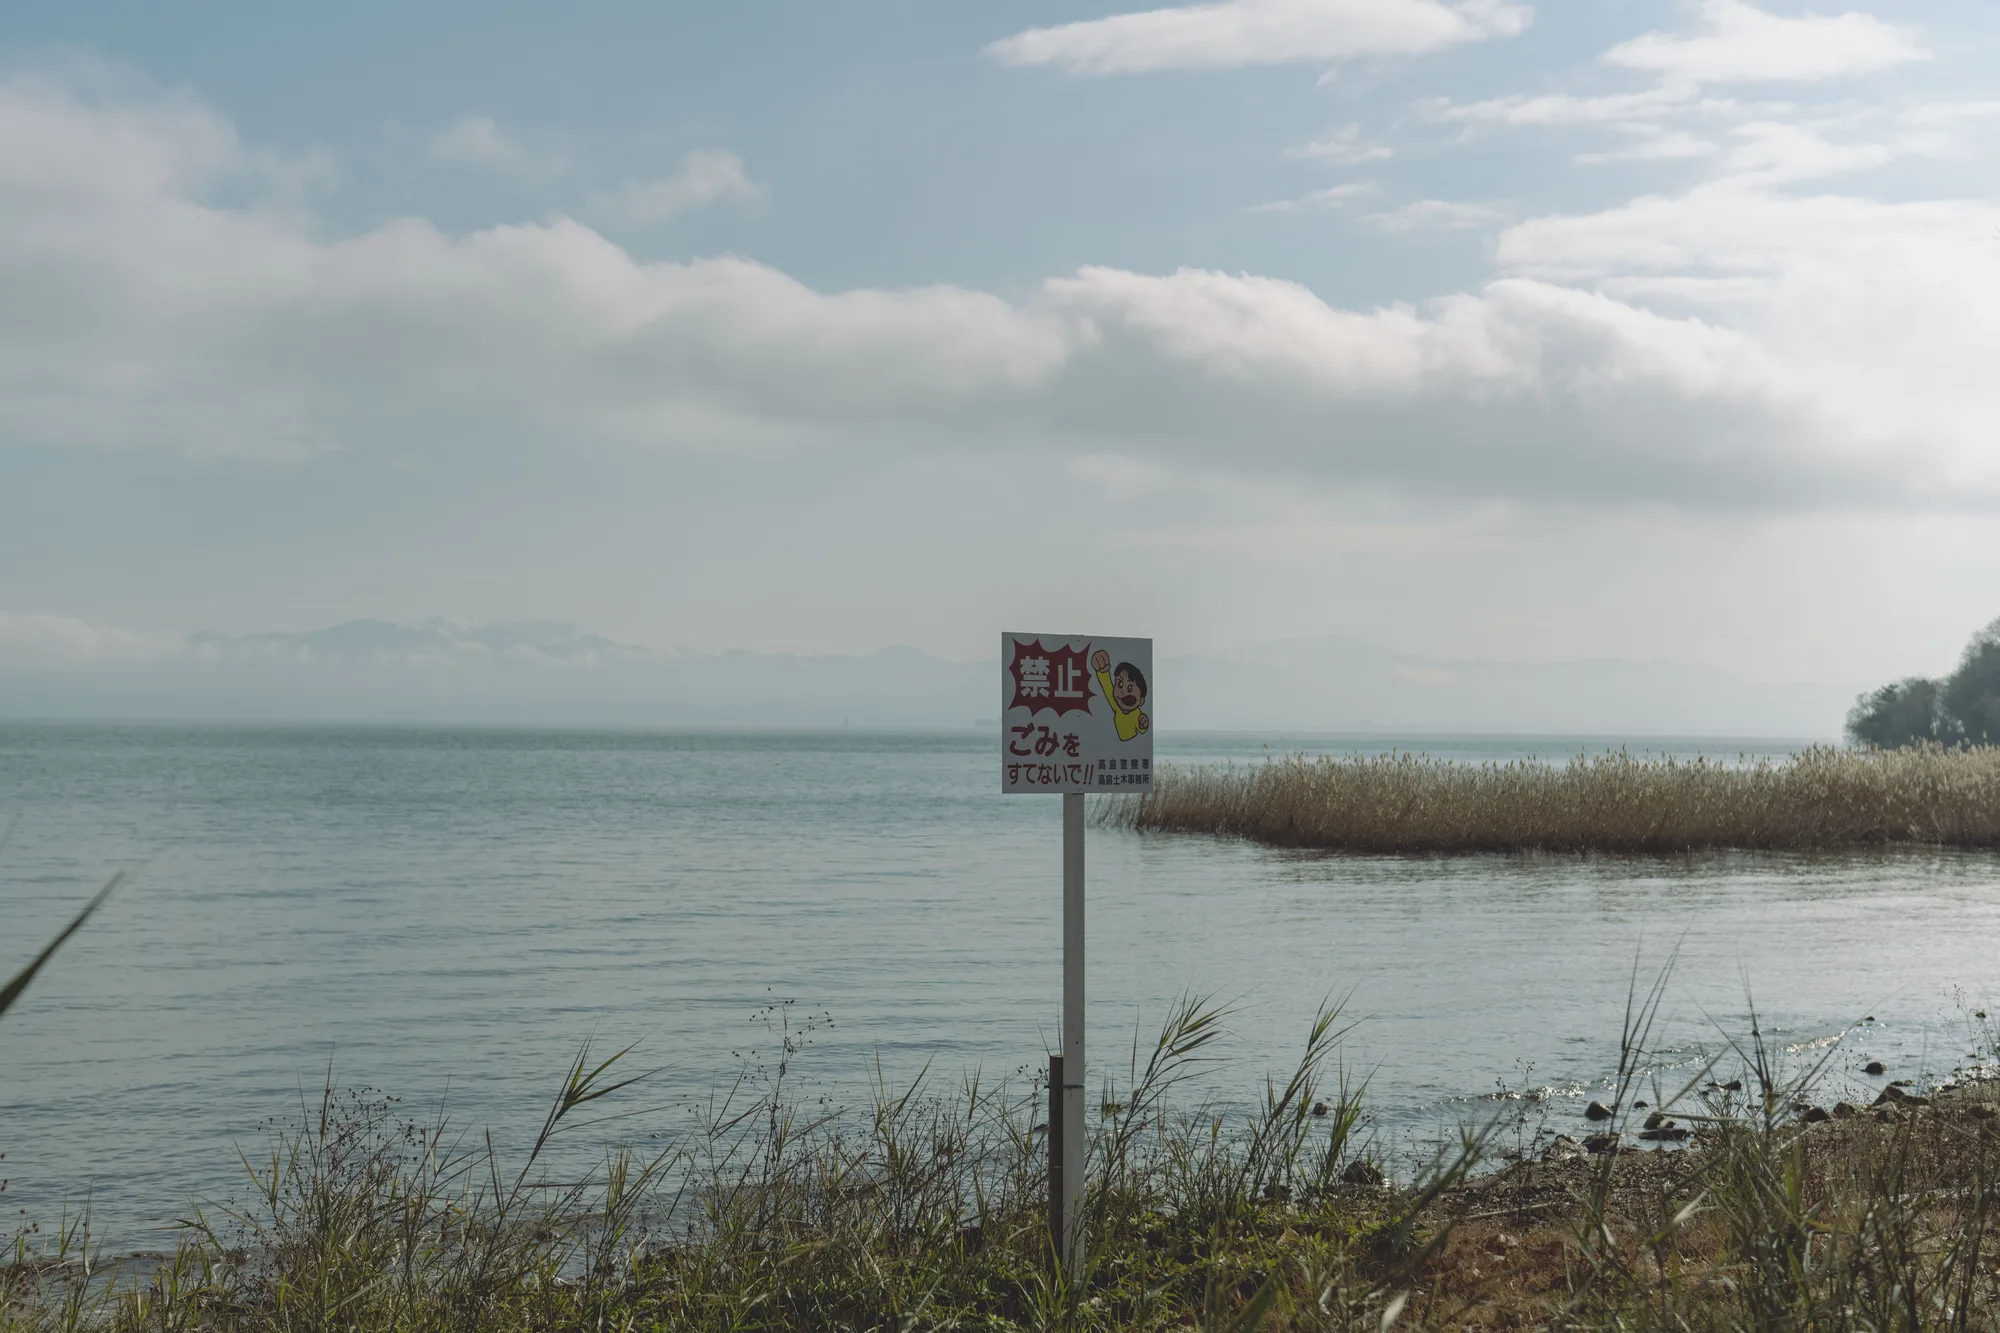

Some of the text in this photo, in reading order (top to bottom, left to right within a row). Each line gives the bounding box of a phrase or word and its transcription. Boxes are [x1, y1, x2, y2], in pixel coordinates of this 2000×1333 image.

[1020, 656, 1083, 698] 禁止
[1009, 722, 1080, 757] ごみを
